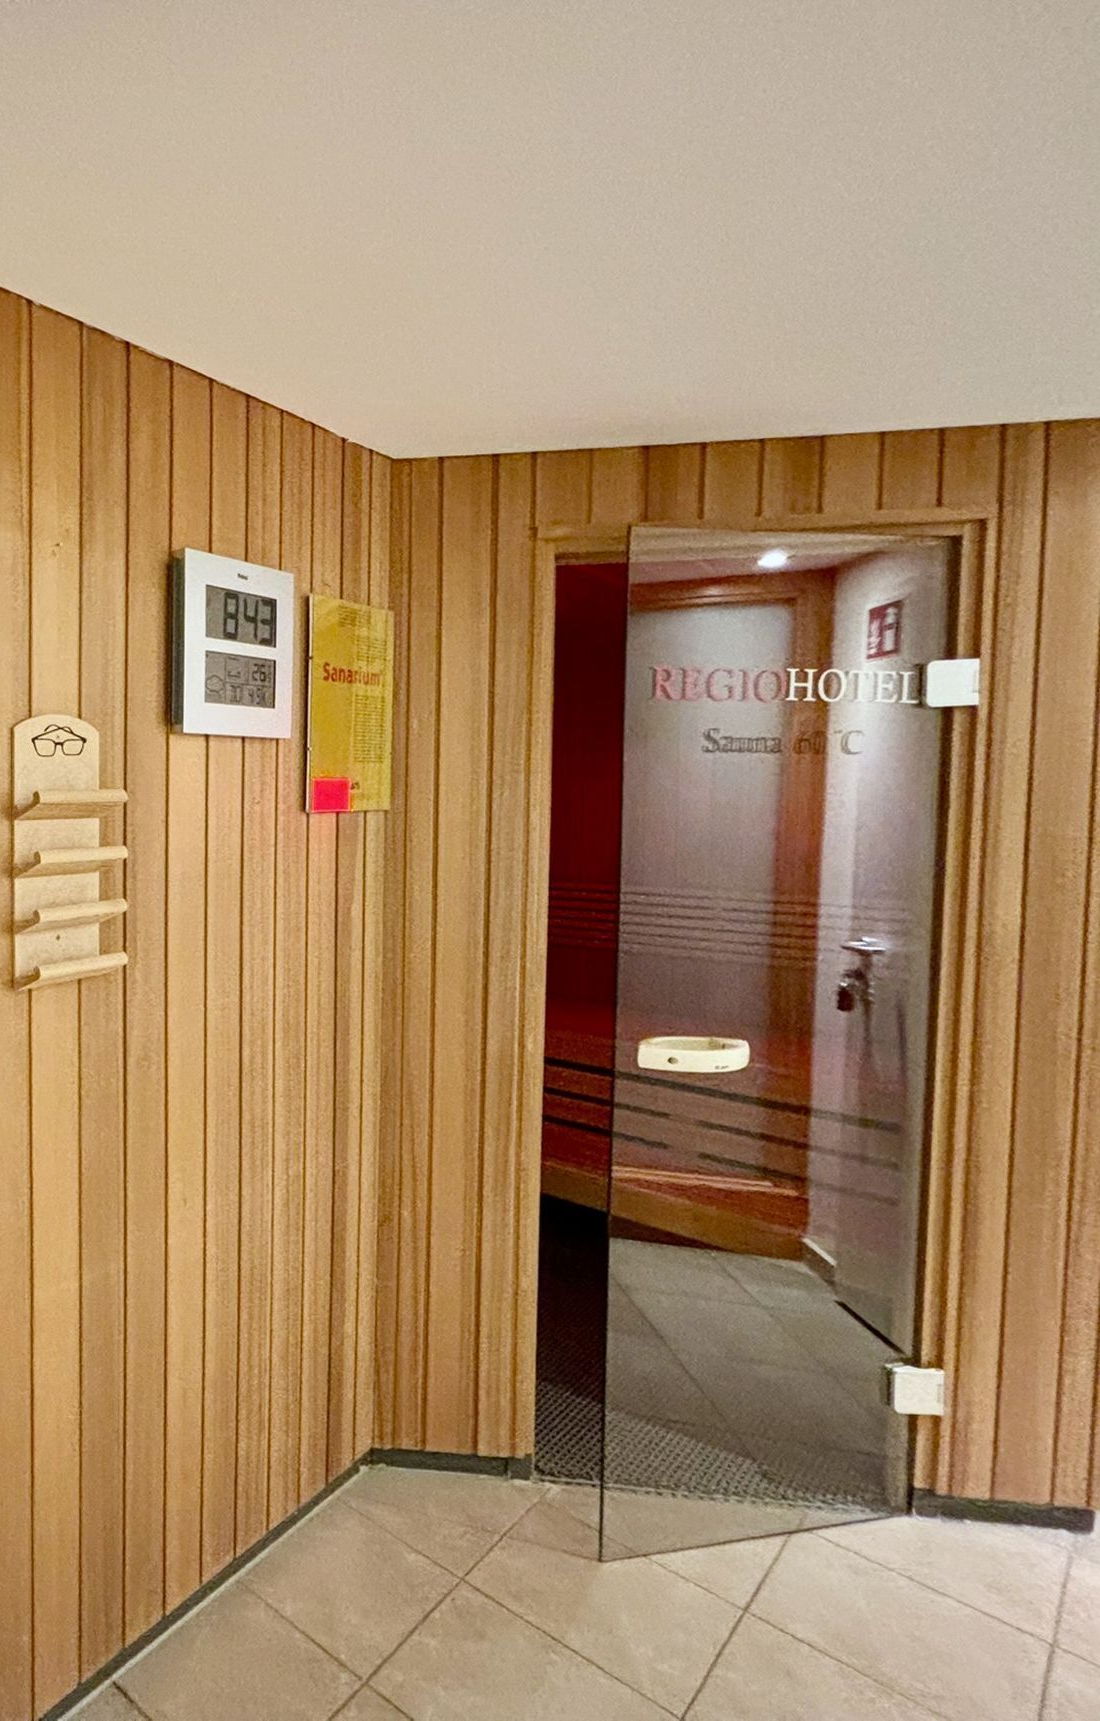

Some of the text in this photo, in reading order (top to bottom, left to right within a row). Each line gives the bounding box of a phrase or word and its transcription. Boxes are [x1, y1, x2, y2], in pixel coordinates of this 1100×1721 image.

[323, 661, 380, 687] Sanarium
[651, 665, 920, 704] REGIOHOTEL
[702, 727, 781, 754] Sauna
